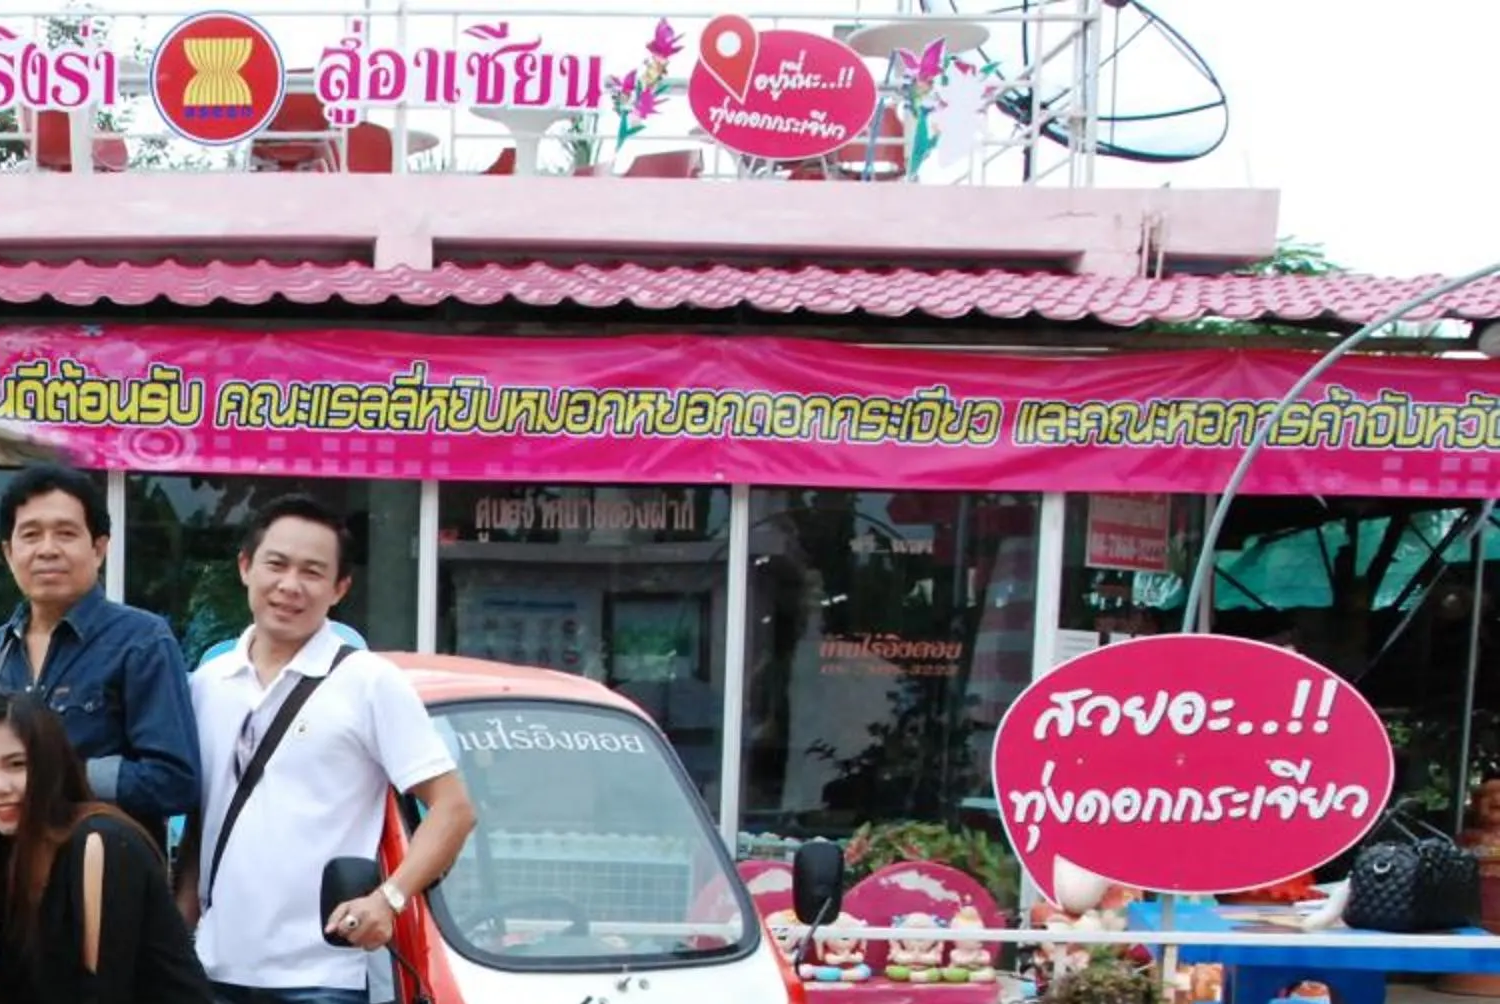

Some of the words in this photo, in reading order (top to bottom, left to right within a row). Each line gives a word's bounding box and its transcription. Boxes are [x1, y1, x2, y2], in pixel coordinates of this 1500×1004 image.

[319, 19, 604, 124] สู่อาเซียน
[457, 713, 646, 753] านไร่อิงดอย
[1008, 758, 1370, 853] ทุ่งดอกกระเจียว
